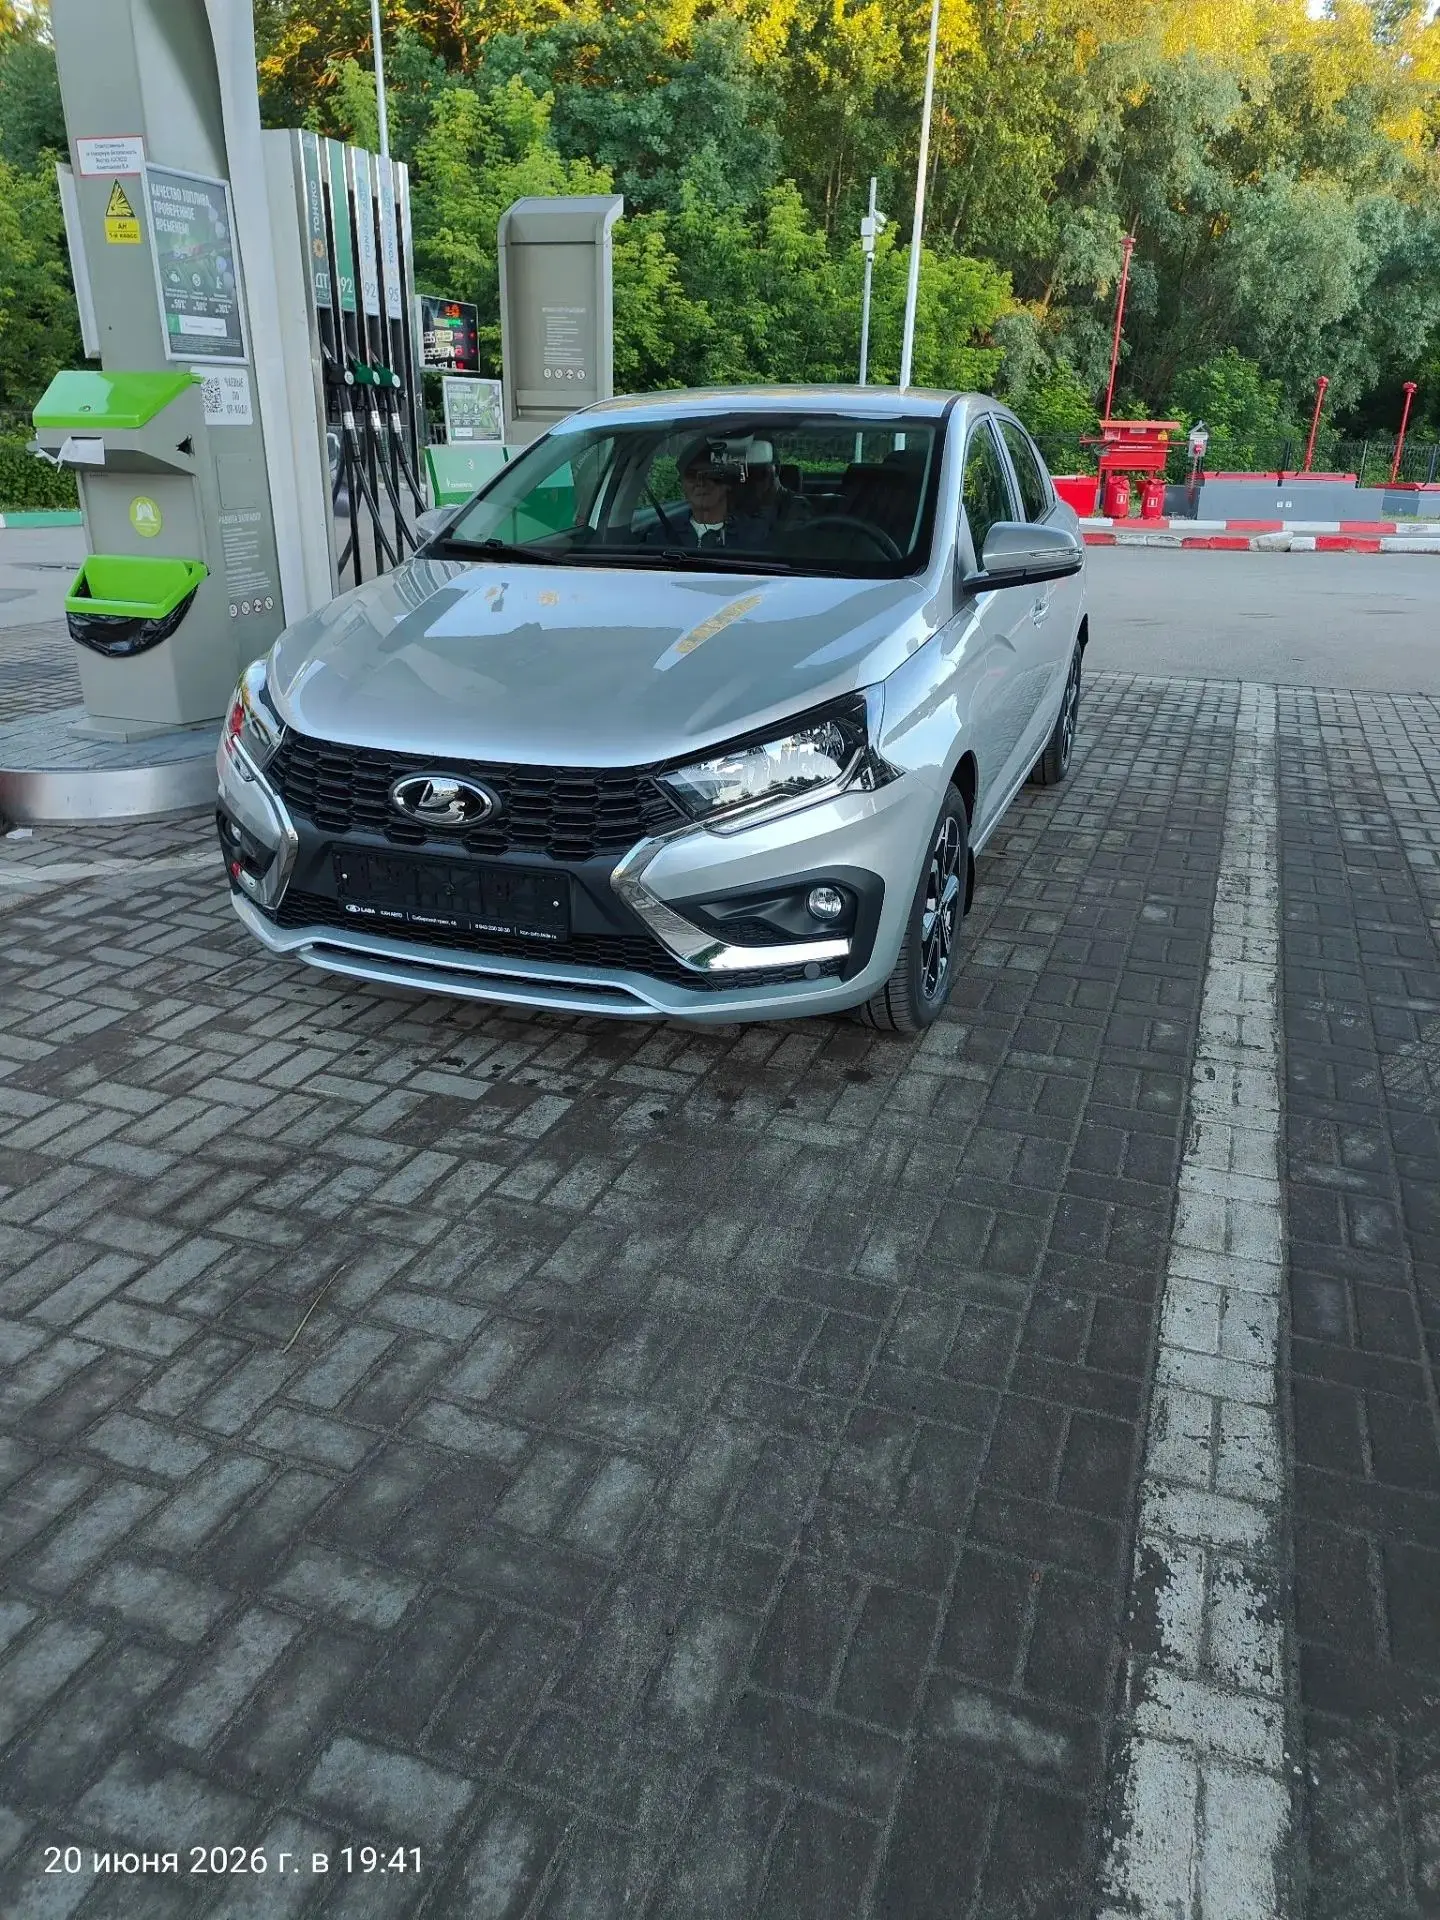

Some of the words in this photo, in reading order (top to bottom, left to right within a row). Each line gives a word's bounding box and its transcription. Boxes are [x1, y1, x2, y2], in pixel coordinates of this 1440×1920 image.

[150, 183, 182, 201] КАЧЕСТВО
[153, 200, 195, 220] ПРОВЕРЕННОЕ
[315, 272, 329, 289] ДТ
[340, 276, 353, 293] 92
[364, 281, 376, 298] 92
[388, 286, 399, 302] 95
